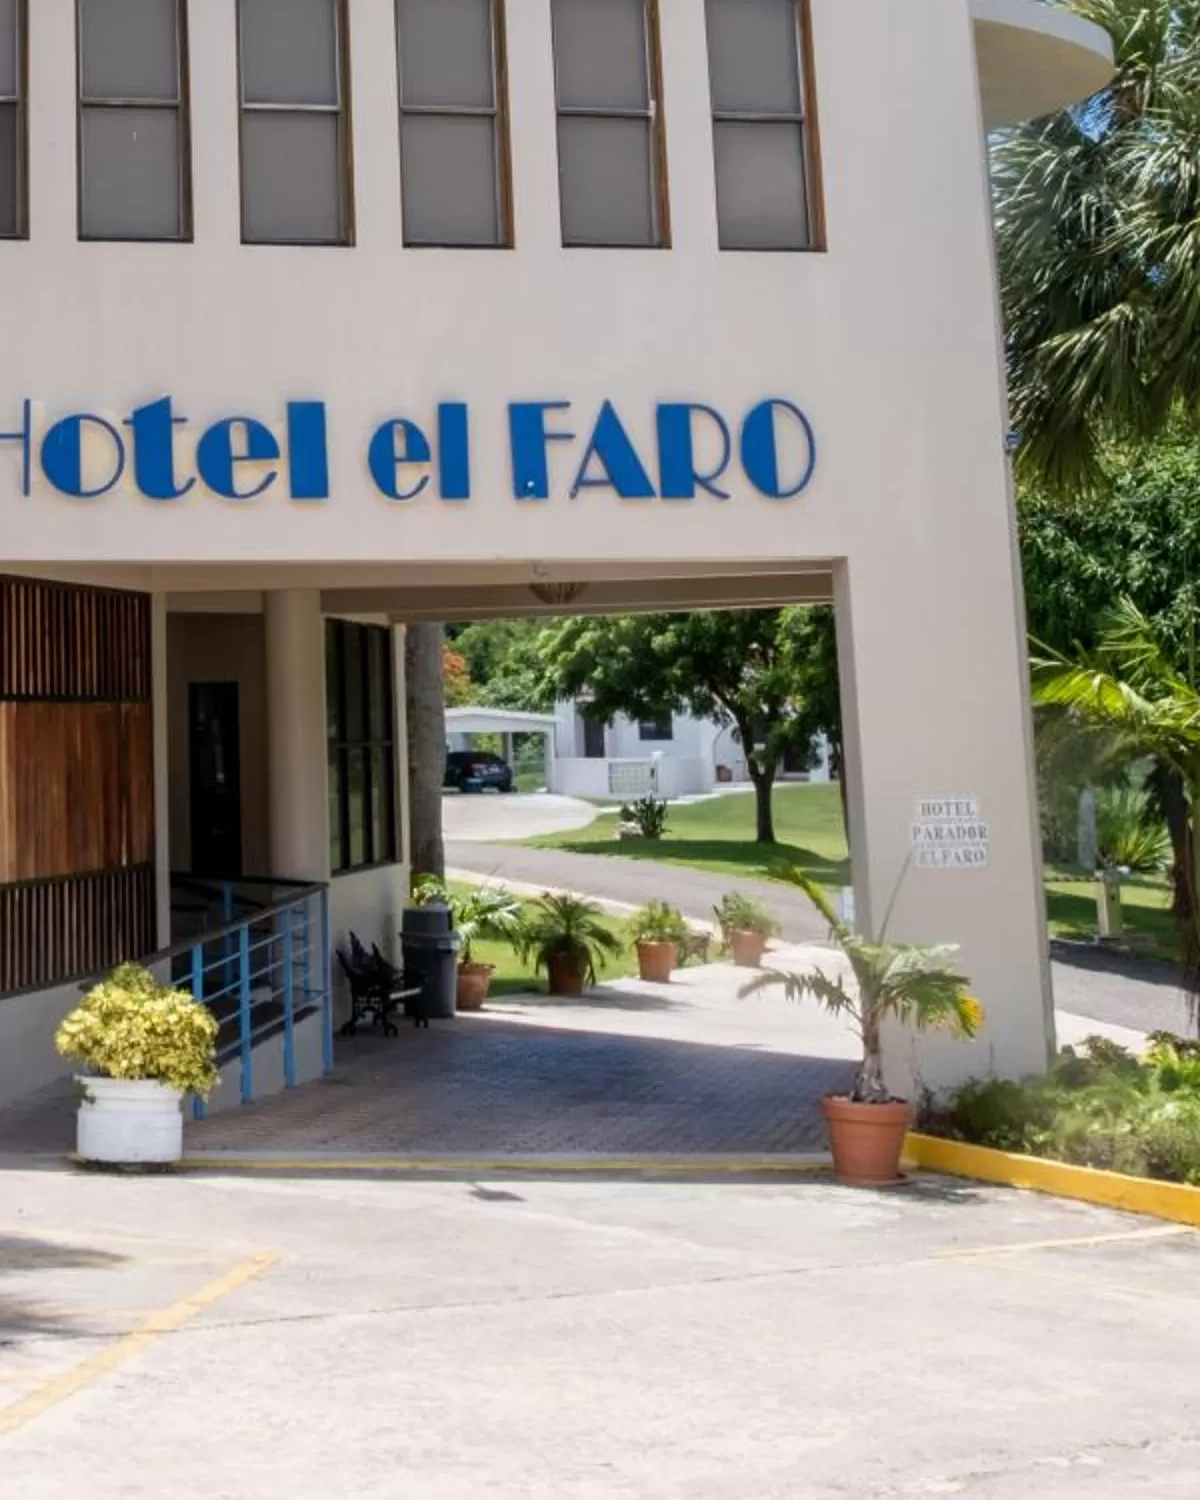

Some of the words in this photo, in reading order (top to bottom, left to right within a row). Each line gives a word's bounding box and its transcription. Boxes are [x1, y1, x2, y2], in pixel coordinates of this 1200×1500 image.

[368, 402, 470, 501] el
[508, 399, 816, 501] FARO
[920, 801, 975, 816] HOTEL
[911, 824, 988, 840] PARADOR
